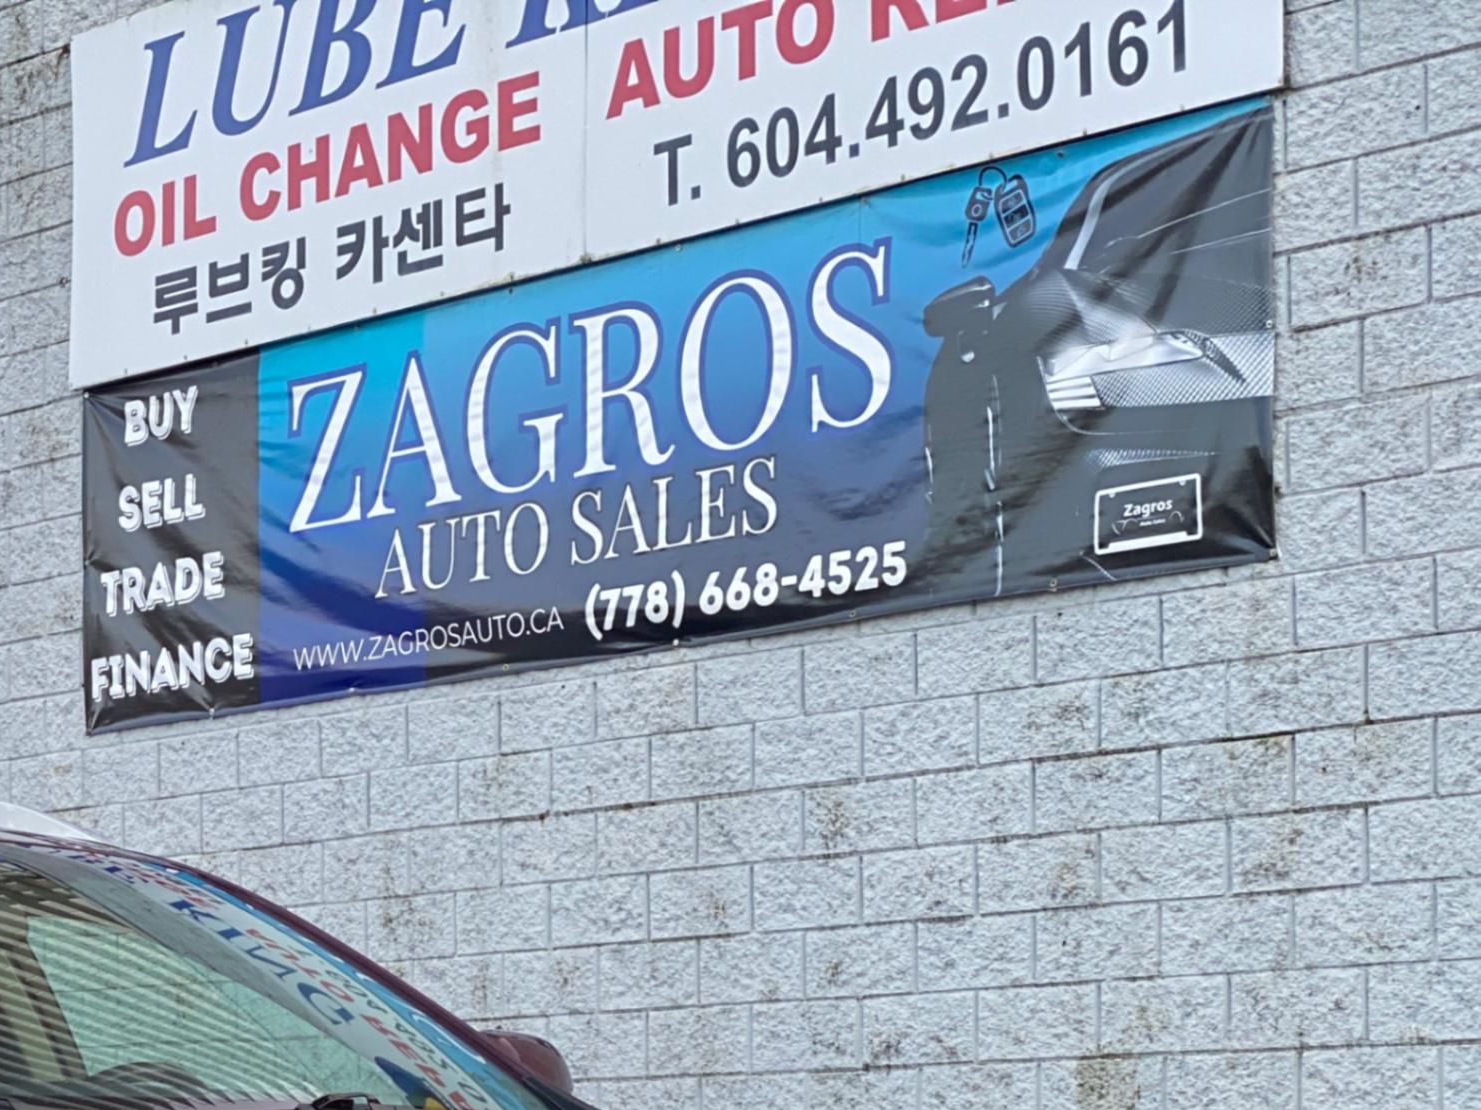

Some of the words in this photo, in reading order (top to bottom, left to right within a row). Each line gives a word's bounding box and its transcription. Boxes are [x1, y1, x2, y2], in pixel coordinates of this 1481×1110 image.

[124, 0, 466, 167] LUBE
[606, 0, 835, 119] AUTO
[653, 133, 702, 207] T.
[726, 0, 1188, 189] 604.492.0161
[114, 175, 217, 257] OIL
[239, 71, 542, 221] CHANGE
[153, 237, 307, 334] 루브킹
[336, 183, 511, 284] 카센타
[123, 385, 198, 447] BUY
[287, 243, 893, 535] ZAGROS
[118, 473, 206, 533] SELL
[374, 501, 550, 599] AUTO
[570, 456, 778, 566] SALES
[1123, 499, 1173, 518] Zagros
[99, 550, 225, 618] TRADE
[292, 605, 565, 671] WWW.ZAGROSAUTO.CA
[584, 569, 686, 641] (778)
[697, 540, 908, 616] 668-4525
[90, 632, 255, 703] FINANCE
